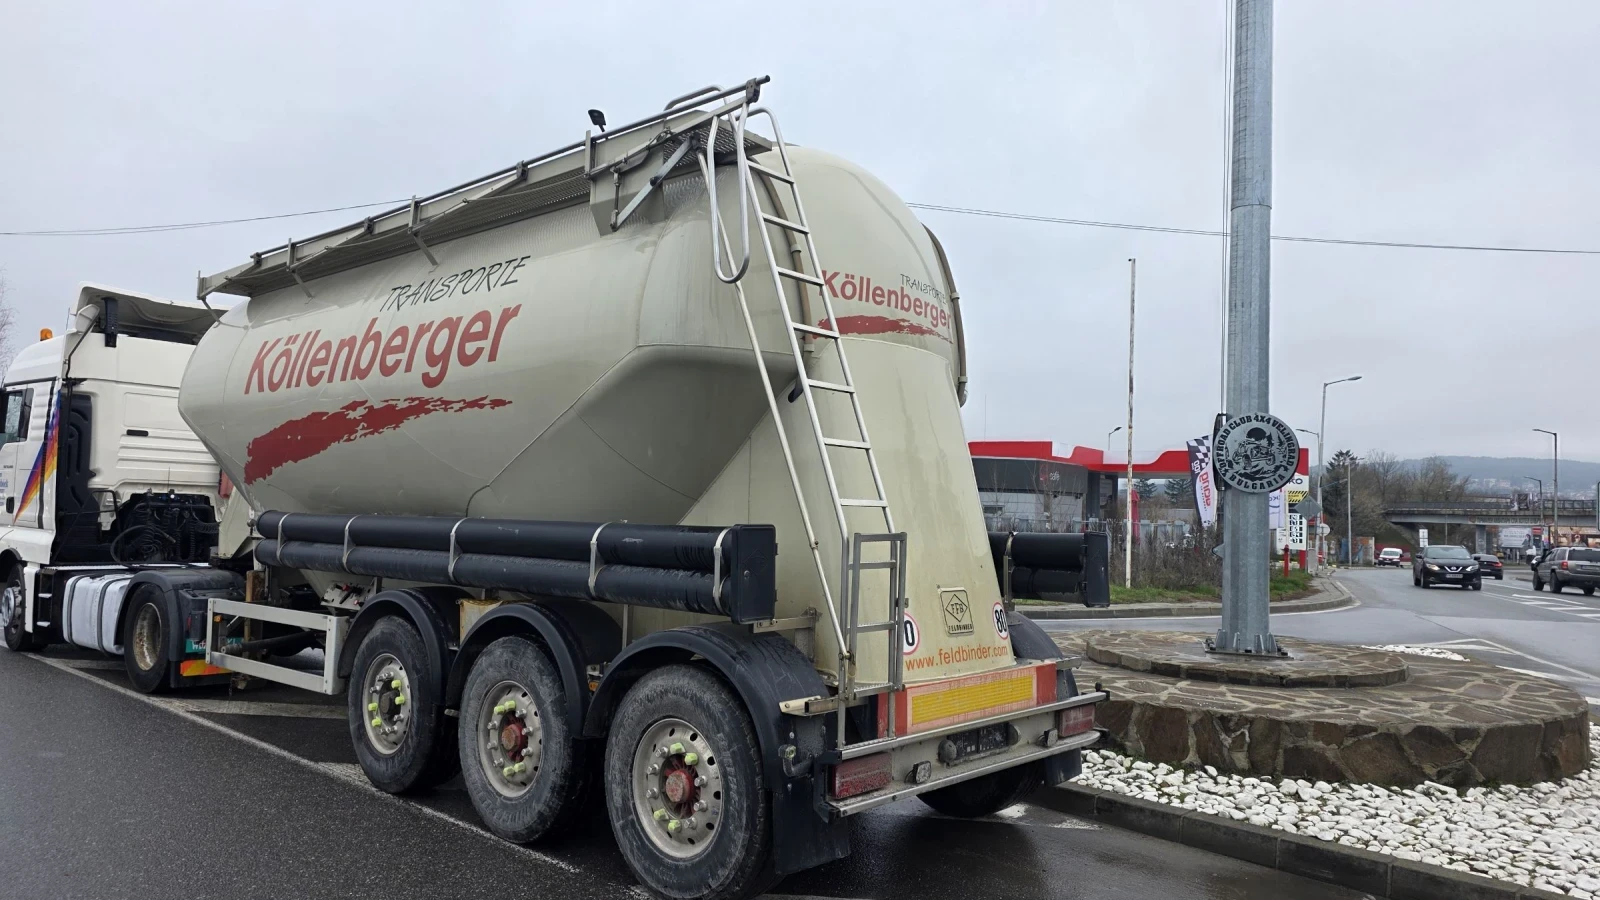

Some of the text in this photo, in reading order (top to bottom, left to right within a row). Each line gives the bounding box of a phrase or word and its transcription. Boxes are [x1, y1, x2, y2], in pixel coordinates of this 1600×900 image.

[380, 256, 531, 312] TRANSPORTE
[819, 269, 952, 330] Köllenberger
[900, 273, 948, 305] TRANSPORTE
[244, 303, 522, 395] Köllenberger
[1216, 428, 1231, 468] OFFROAD
[1229, 415, 1252, 431] CLUB
[1271, 419, 1296, 467] VELINGRAD
[1229, 473, 1286, 490] BULGARIA
[951, 602, 964, 615] FFB
[995, 608, 1007, 633] 80
[905, 644, 1008, 671] www.feldbinder.com
